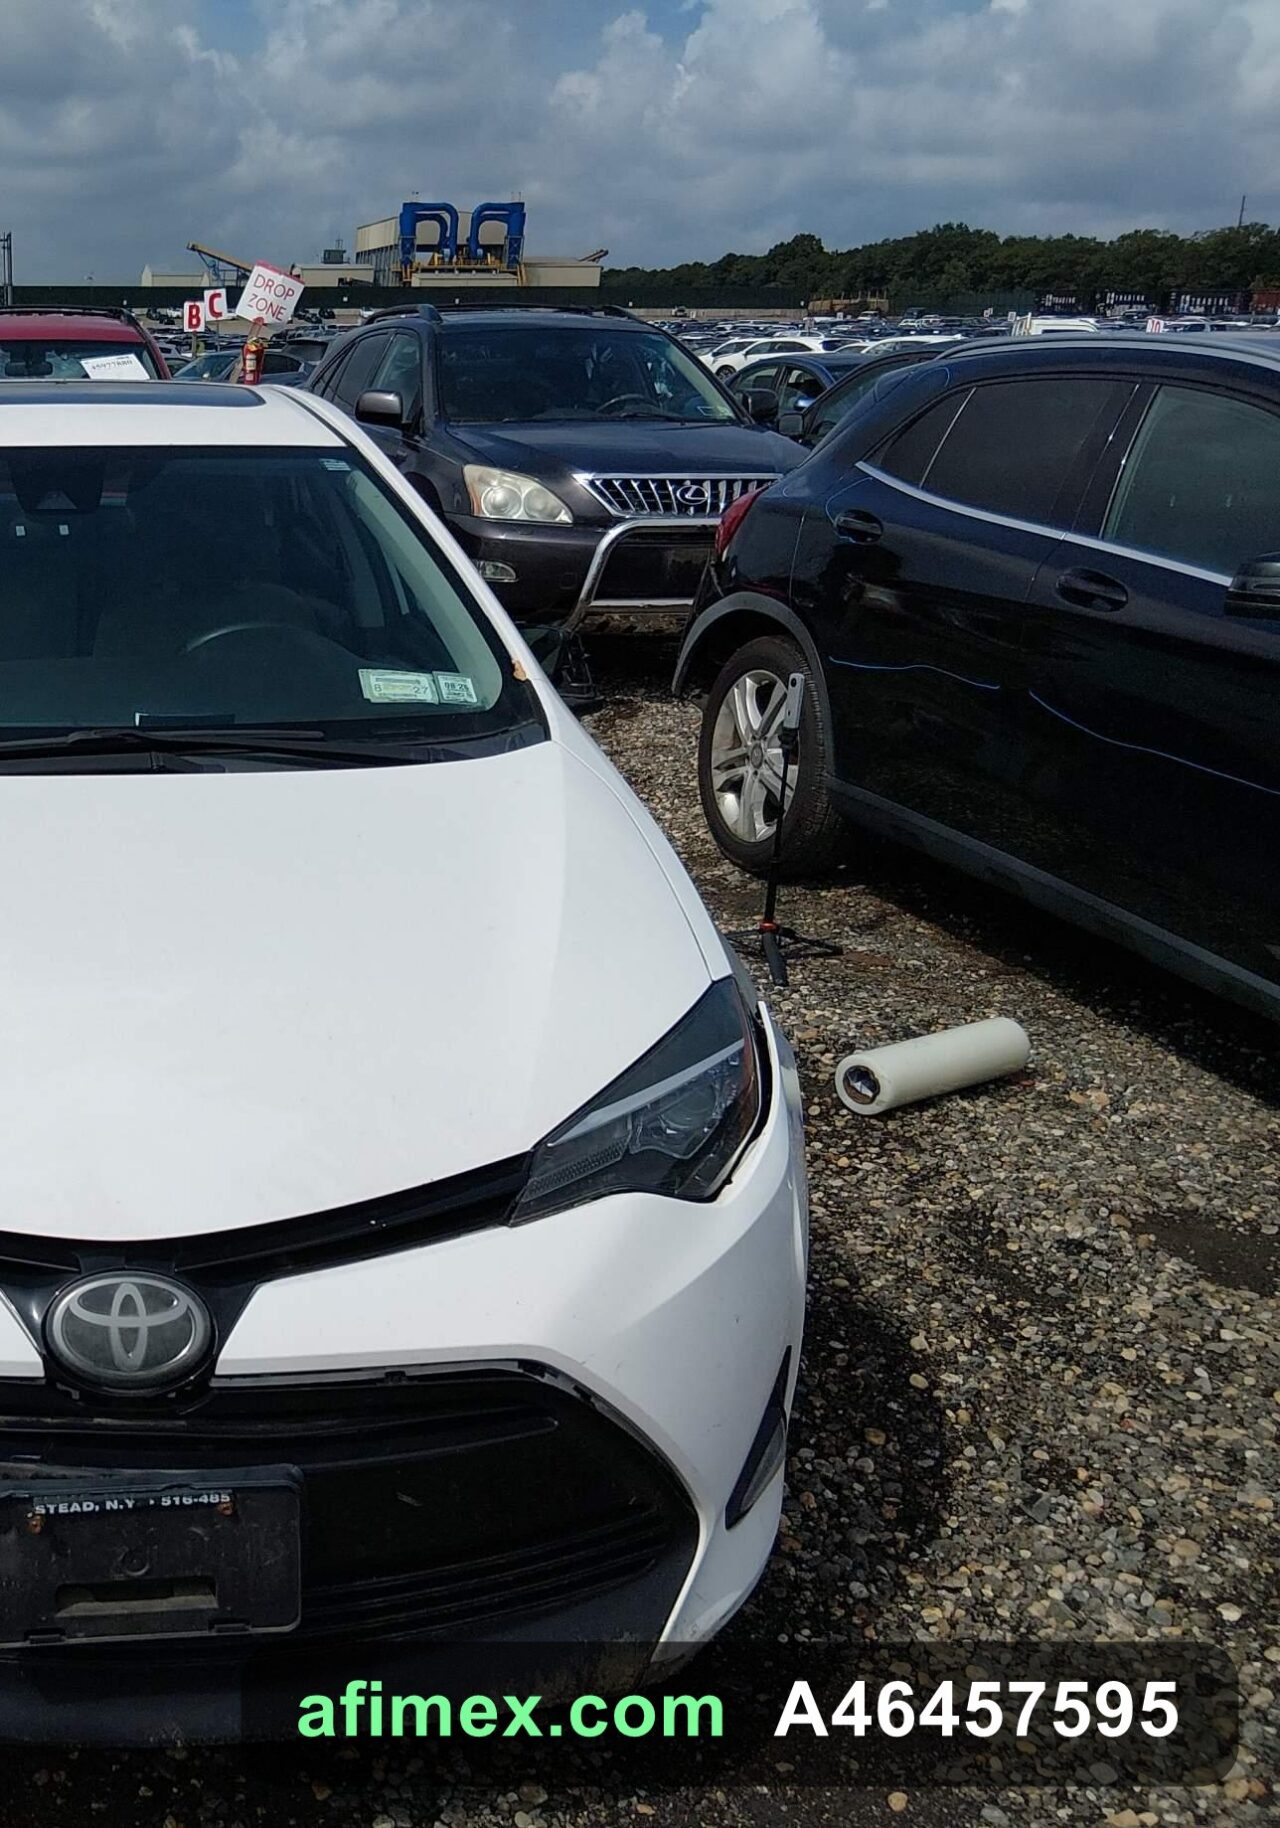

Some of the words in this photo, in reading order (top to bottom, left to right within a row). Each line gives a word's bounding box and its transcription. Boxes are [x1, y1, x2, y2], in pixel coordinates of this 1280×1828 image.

[253, 274, 295, 300] DROP
[187, 304, 201, 329] B
[208, 292, 223, 318] C
[247, 293, 287, 322] ZONE
[27, 1500, 100, 1517] STEAD,
